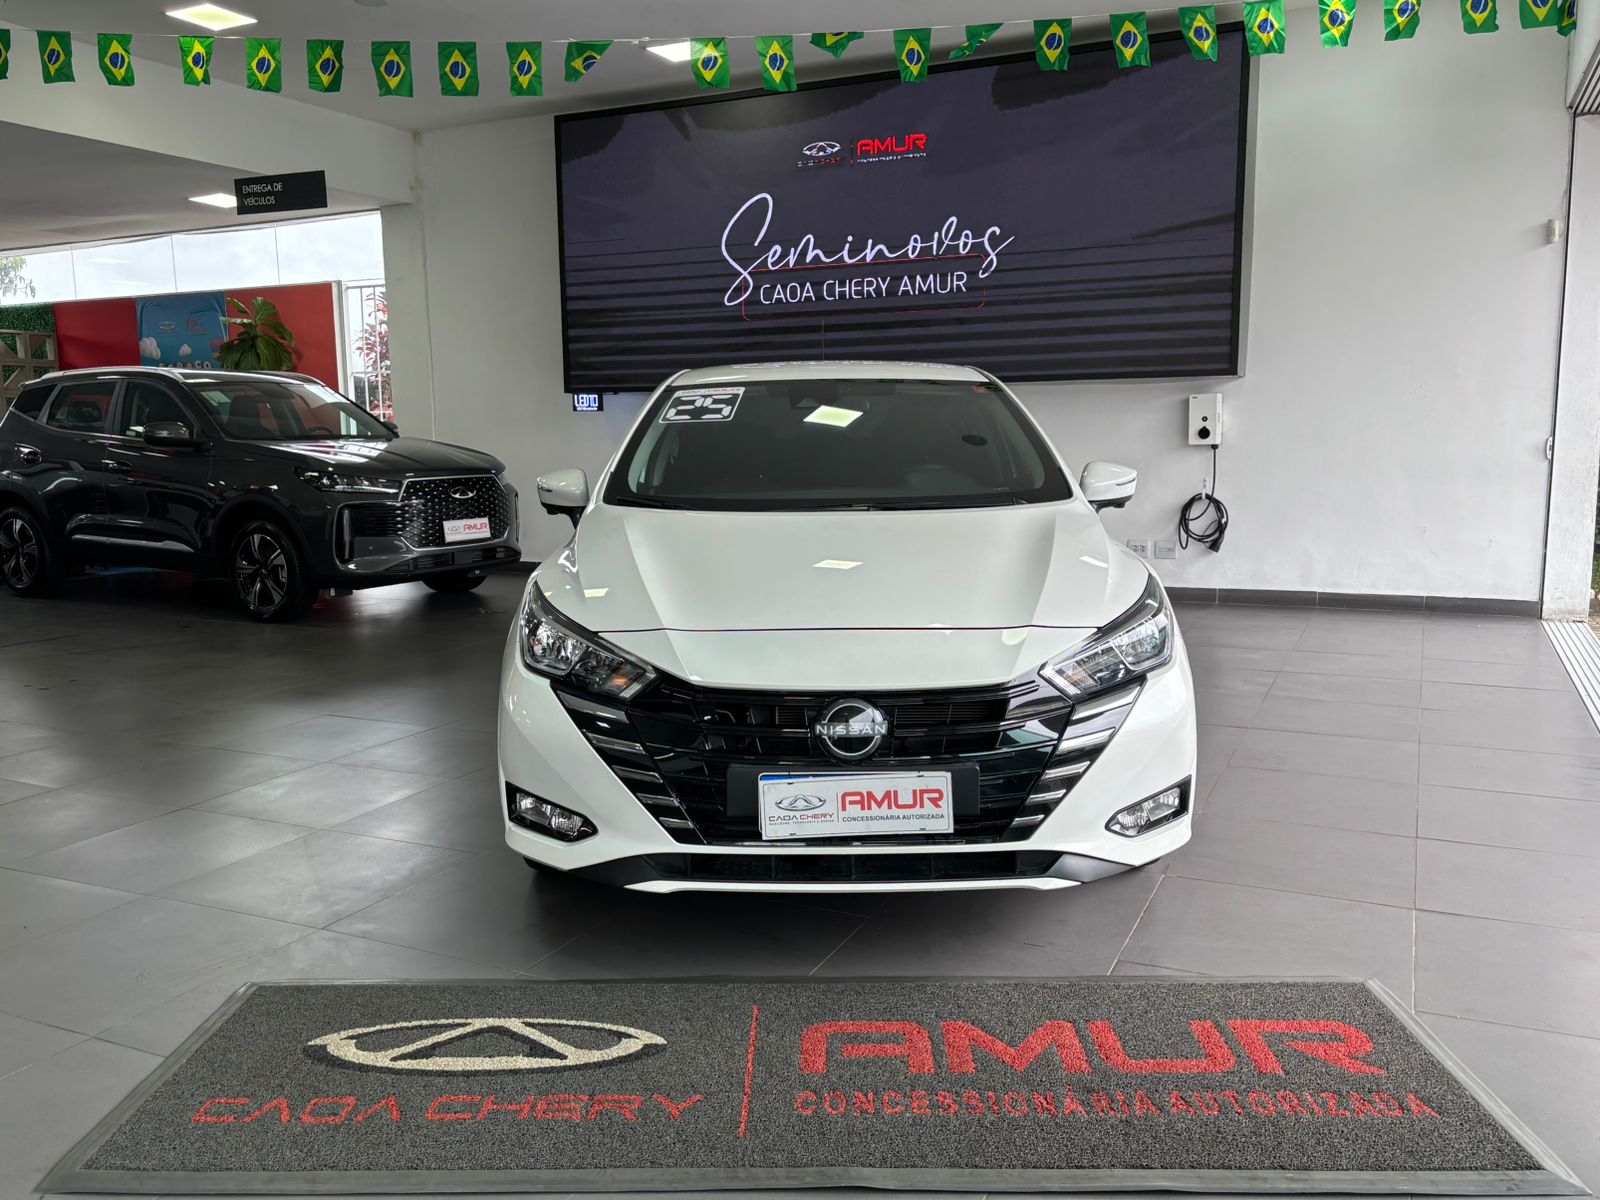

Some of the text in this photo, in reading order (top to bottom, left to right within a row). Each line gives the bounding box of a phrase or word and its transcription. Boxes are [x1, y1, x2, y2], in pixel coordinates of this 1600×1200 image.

[857, 133, 928, 156] AMUR
[242, 182, 283, 194] ENTREGA DE
[243, 195, 276, 206] VEÍCULOS
[721, 193, 1015, 306] Seminovos
[760, 271, 967, 304] CAOA CHERY AMUR
[666, 395, 733, 420] 25
[463, 522, 488, 532] AMUR
[816, 724, 886, 735] NISSAN
[841, 788, 945, 812] AMUR
[842, 813, 945, 823] CONCESSIONÁRIA AUTORIZADA
[800, 1019, 1388, 1076] AMUR
[191, 1093, 706, 1125] CAOA CHERY
[796, 1086, 1441, 1119] CONCESSIONÁRIA AUTORIZADA
